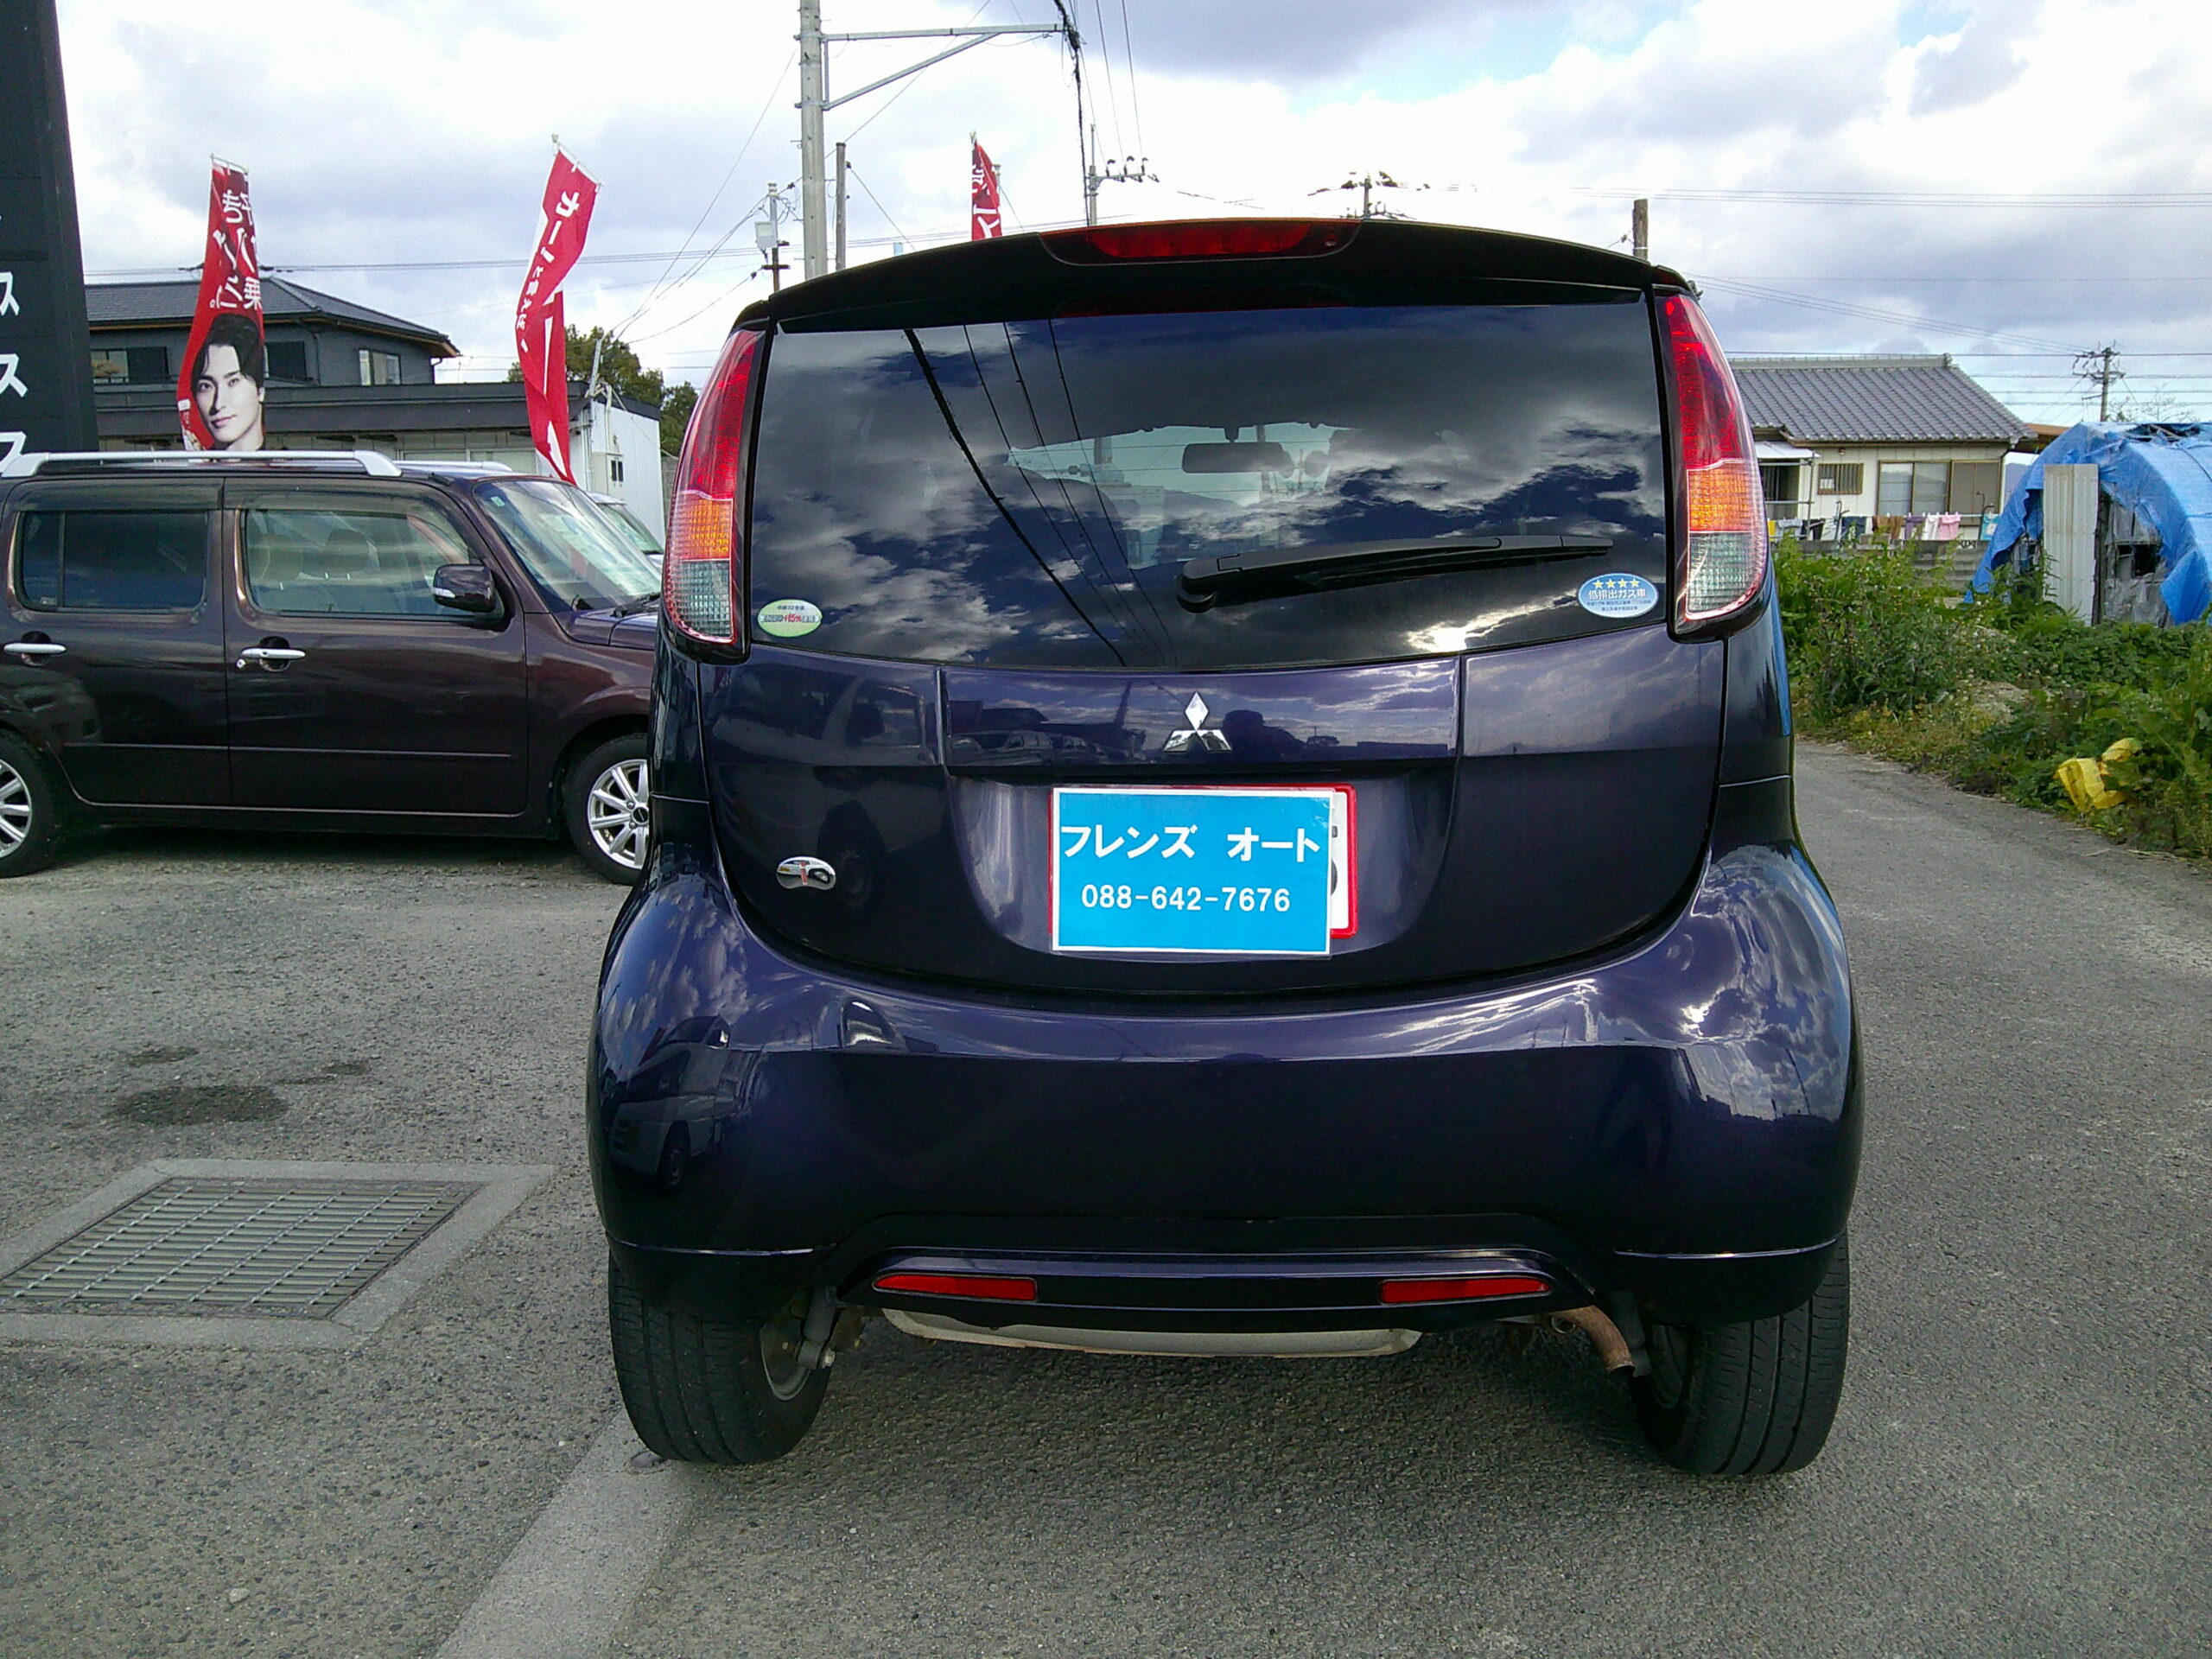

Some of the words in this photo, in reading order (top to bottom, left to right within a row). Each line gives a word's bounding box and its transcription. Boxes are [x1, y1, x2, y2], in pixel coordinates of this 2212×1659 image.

[1588, 588, 1646, 600] 低排出ガス車
[1061, 823, 1198, 860] フレンズ
[1227, 827, 1320, 862] オート
[1081, 884, 1291, 912] 088-642-7676
